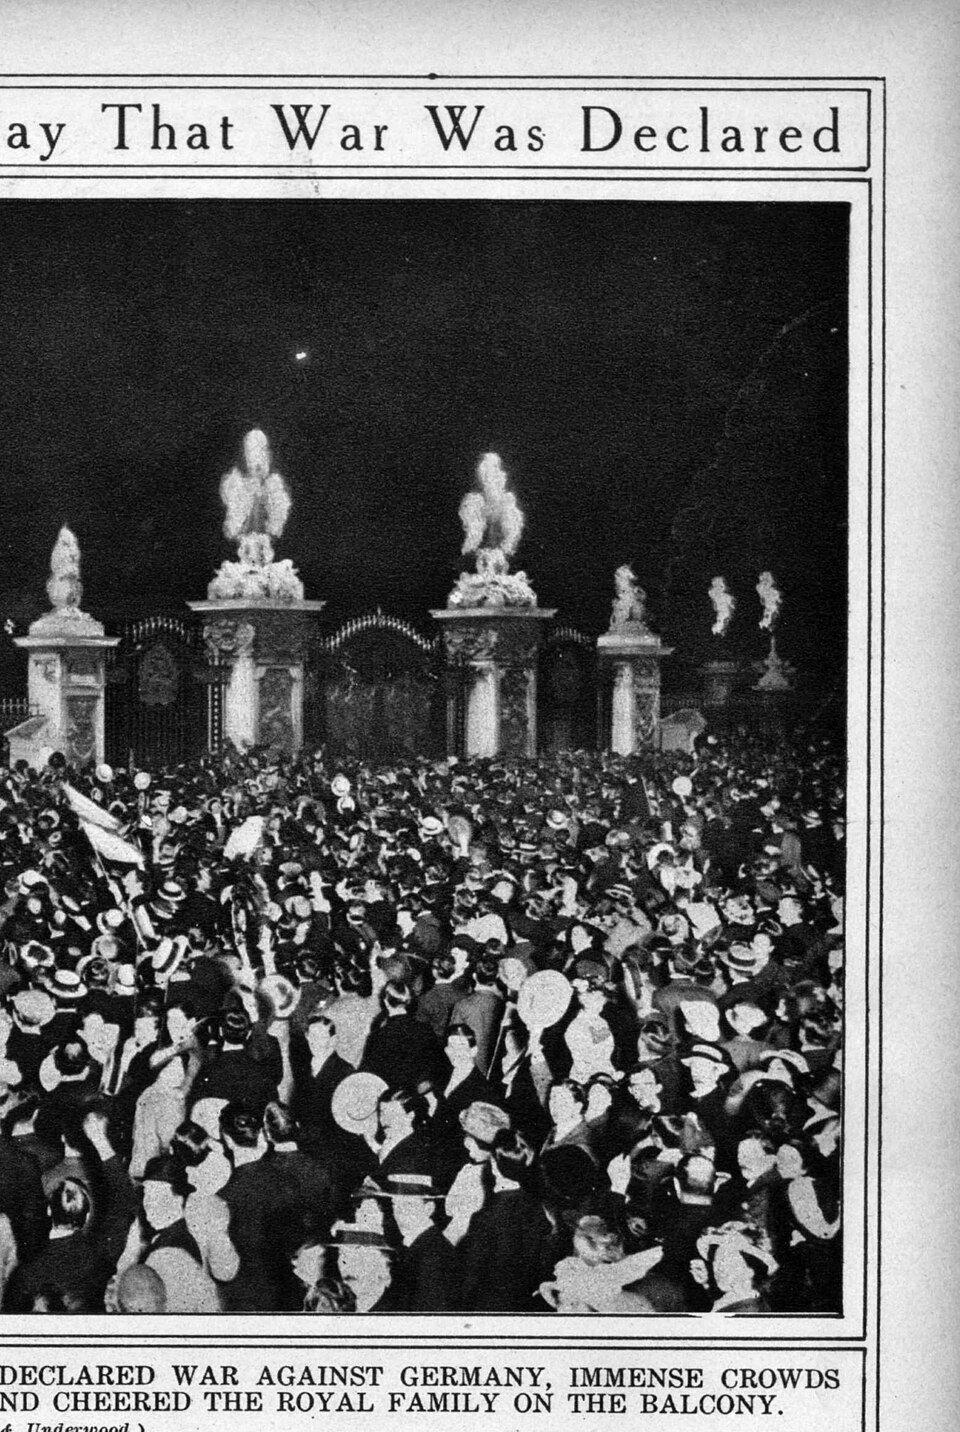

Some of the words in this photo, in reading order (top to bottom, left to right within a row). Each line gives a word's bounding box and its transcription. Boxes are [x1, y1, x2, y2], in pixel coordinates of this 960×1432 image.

[101, 103, 234, 151] That
[269, 104, 389, 152] War
[423, 105, 544, 152] Was
[580, 105, 841, 153] Declared
[171, 1364, 239, 1386] WAR
[255, 1365, 384, 1387] AGAINST
[400, 1365, 552, 1391] GERMANY,
[569, 1367, 704, 1389] IMMENSE
[720, 1368, 841, 1390] CROWDS
[52, 1391, 191, 1413] CHEERED
[203, 1391, 263, 1412] THE
[276, 1391, 375, 1413] ROYAL
[388, 1391, 500, 1413] FAMILY
[513, 1392, 555, 1414] ON
[567, 1392, 627, 1414] THE
[639, 1393, 784, 1416] BALCONY.
